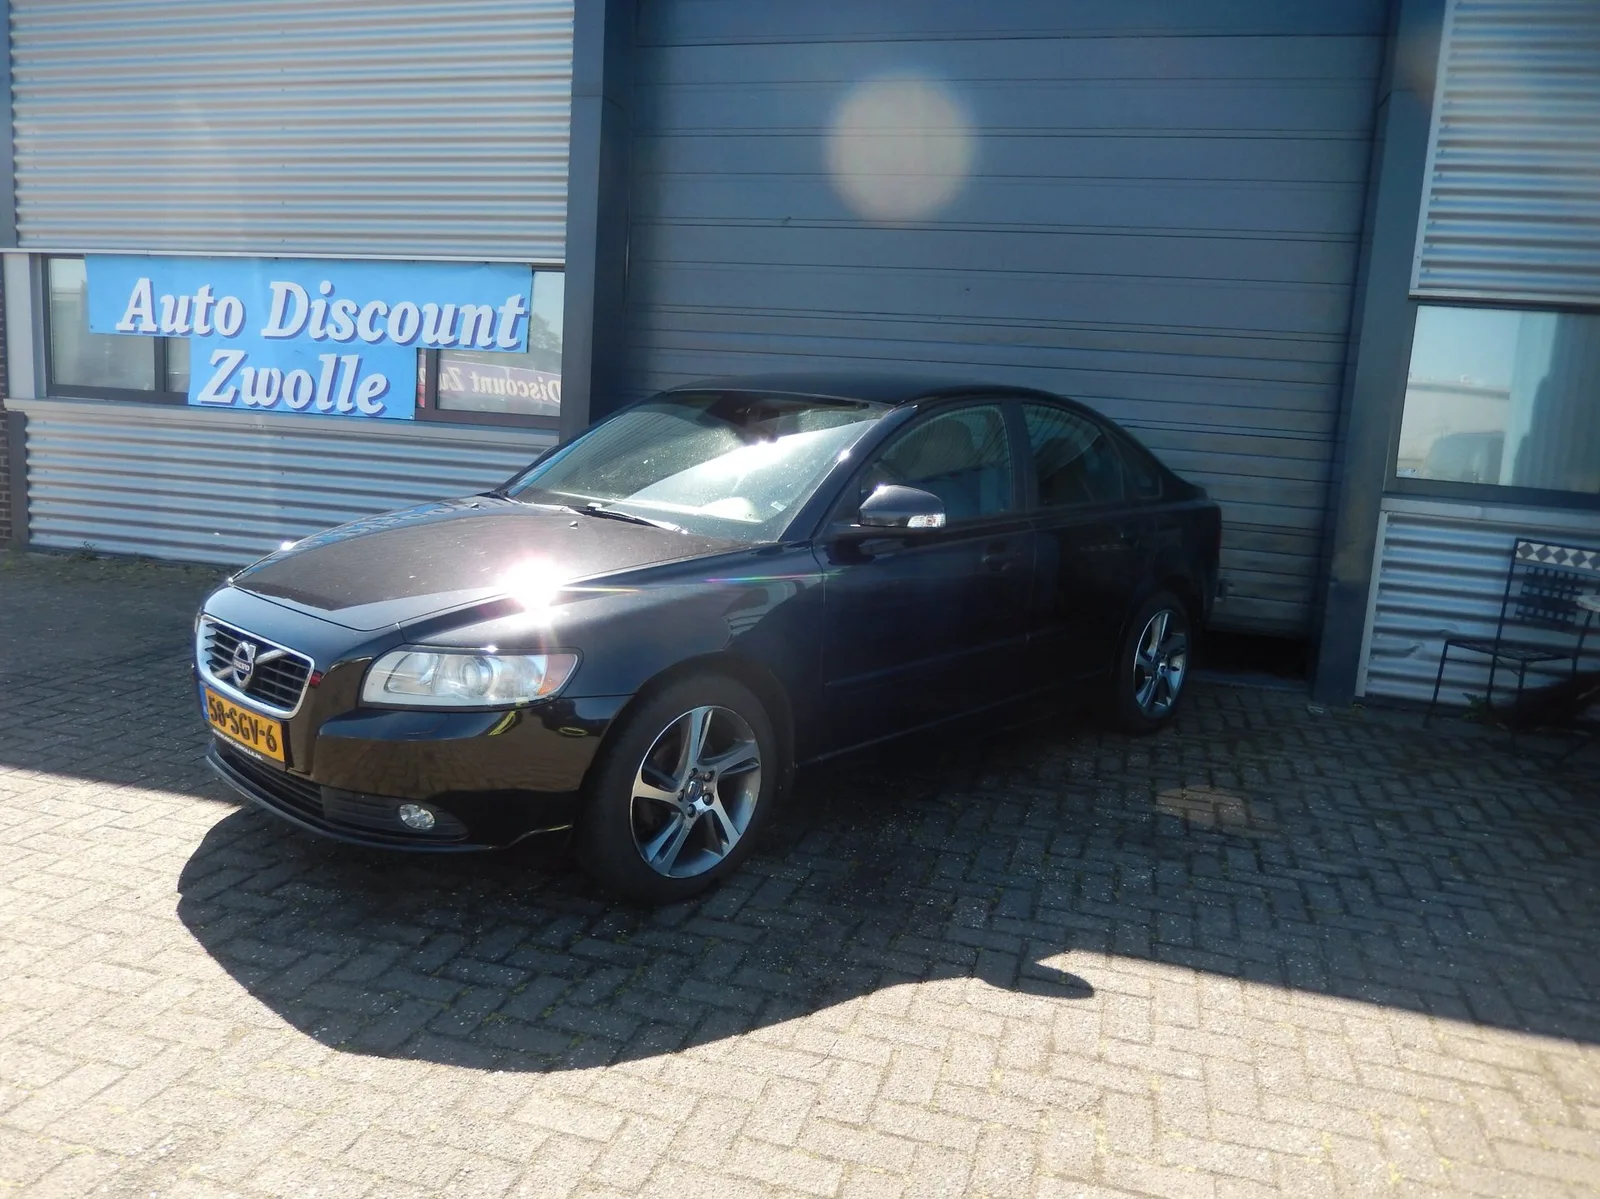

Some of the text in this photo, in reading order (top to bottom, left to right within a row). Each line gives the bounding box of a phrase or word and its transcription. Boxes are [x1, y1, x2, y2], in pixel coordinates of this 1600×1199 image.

[115, 277, 527, 350] Auto Discount
[198, 348, 390, 416] Zwolle
[208, 695, 278, 752] 58-SGV-6
